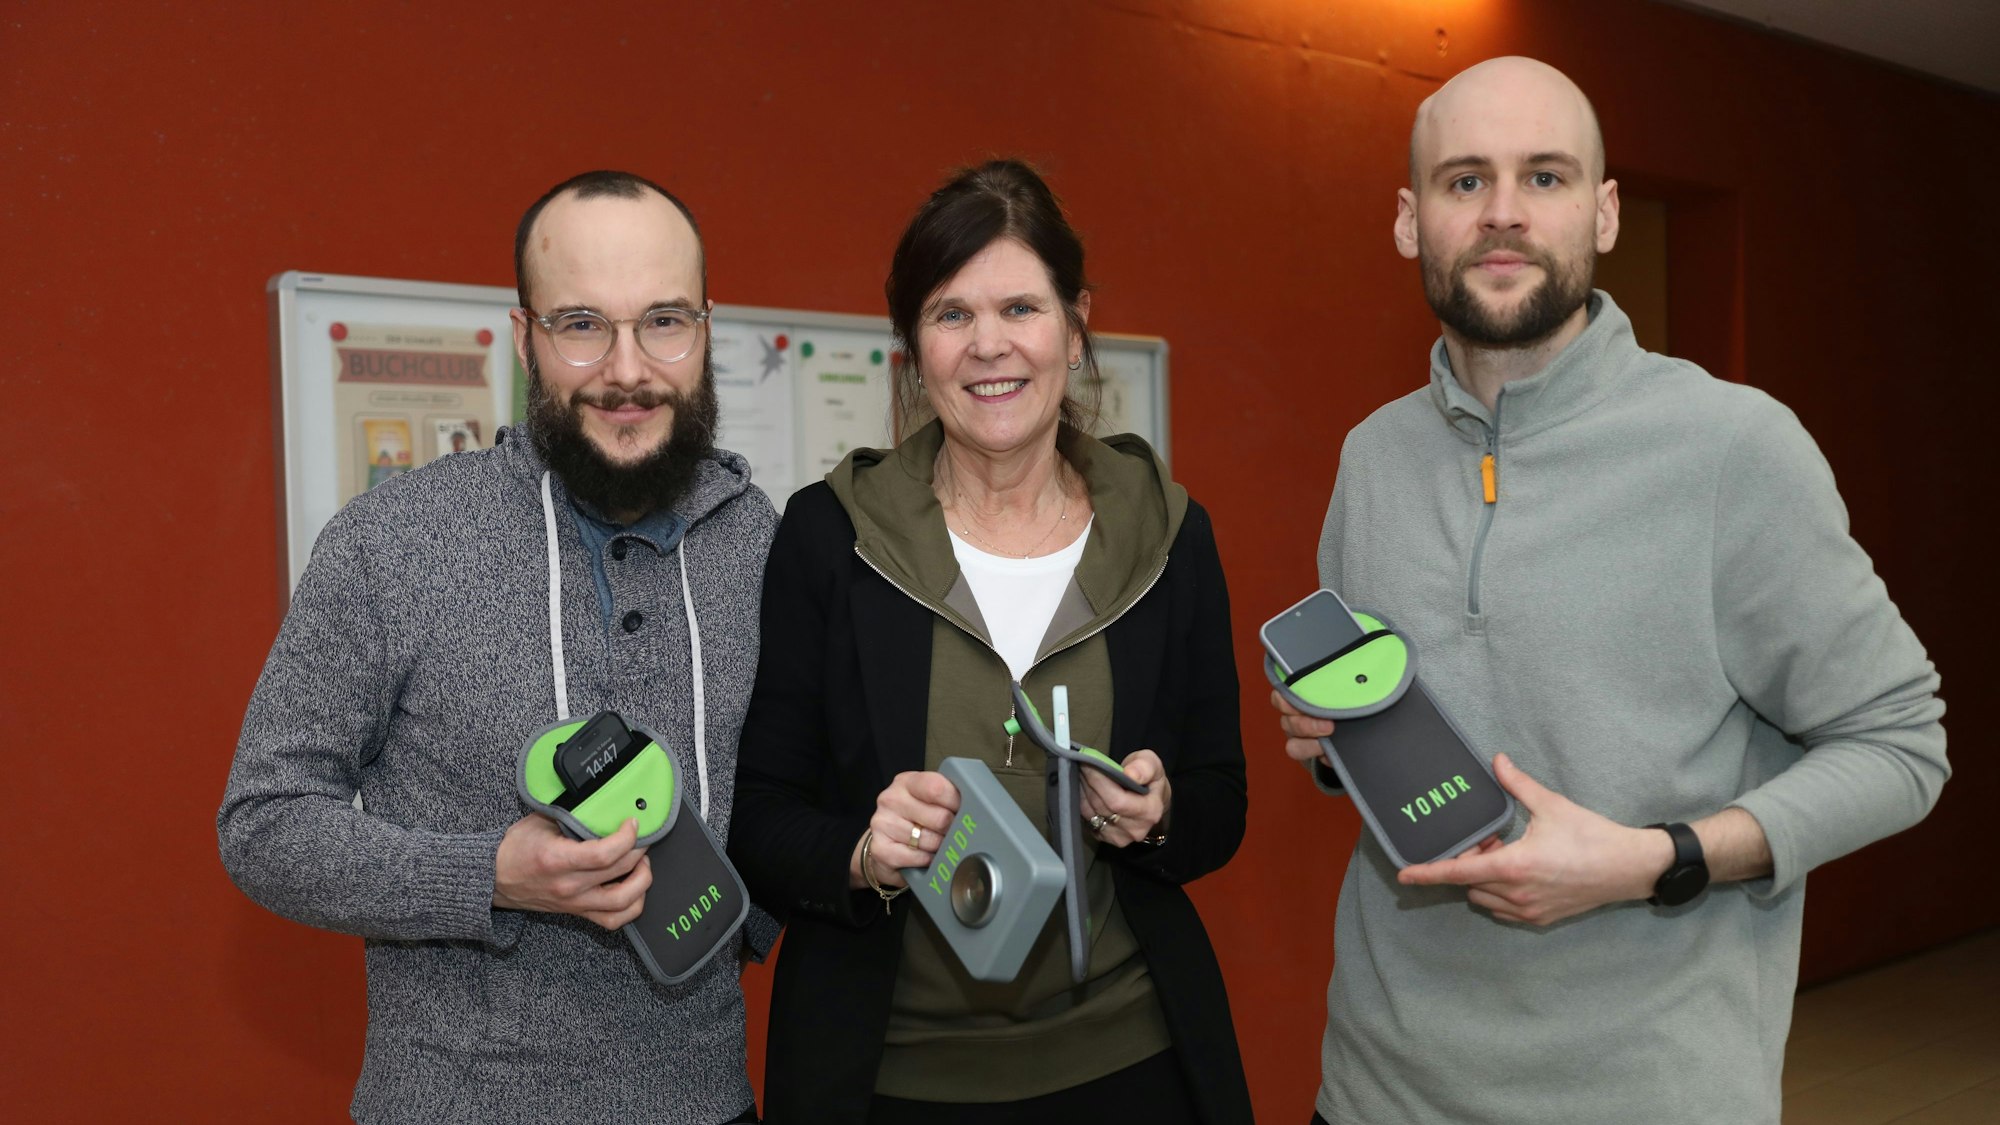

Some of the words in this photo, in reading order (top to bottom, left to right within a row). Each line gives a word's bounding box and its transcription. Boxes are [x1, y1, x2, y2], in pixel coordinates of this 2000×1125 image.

[350, 353, 480, 380] BUCHCLUB
[586, 743, 617, 778] 14:47
[1401, 775, 1471, 822] YONDR
[929, 814, 977, 894] YONDR
[666, 885, 721, 939] YONDR
